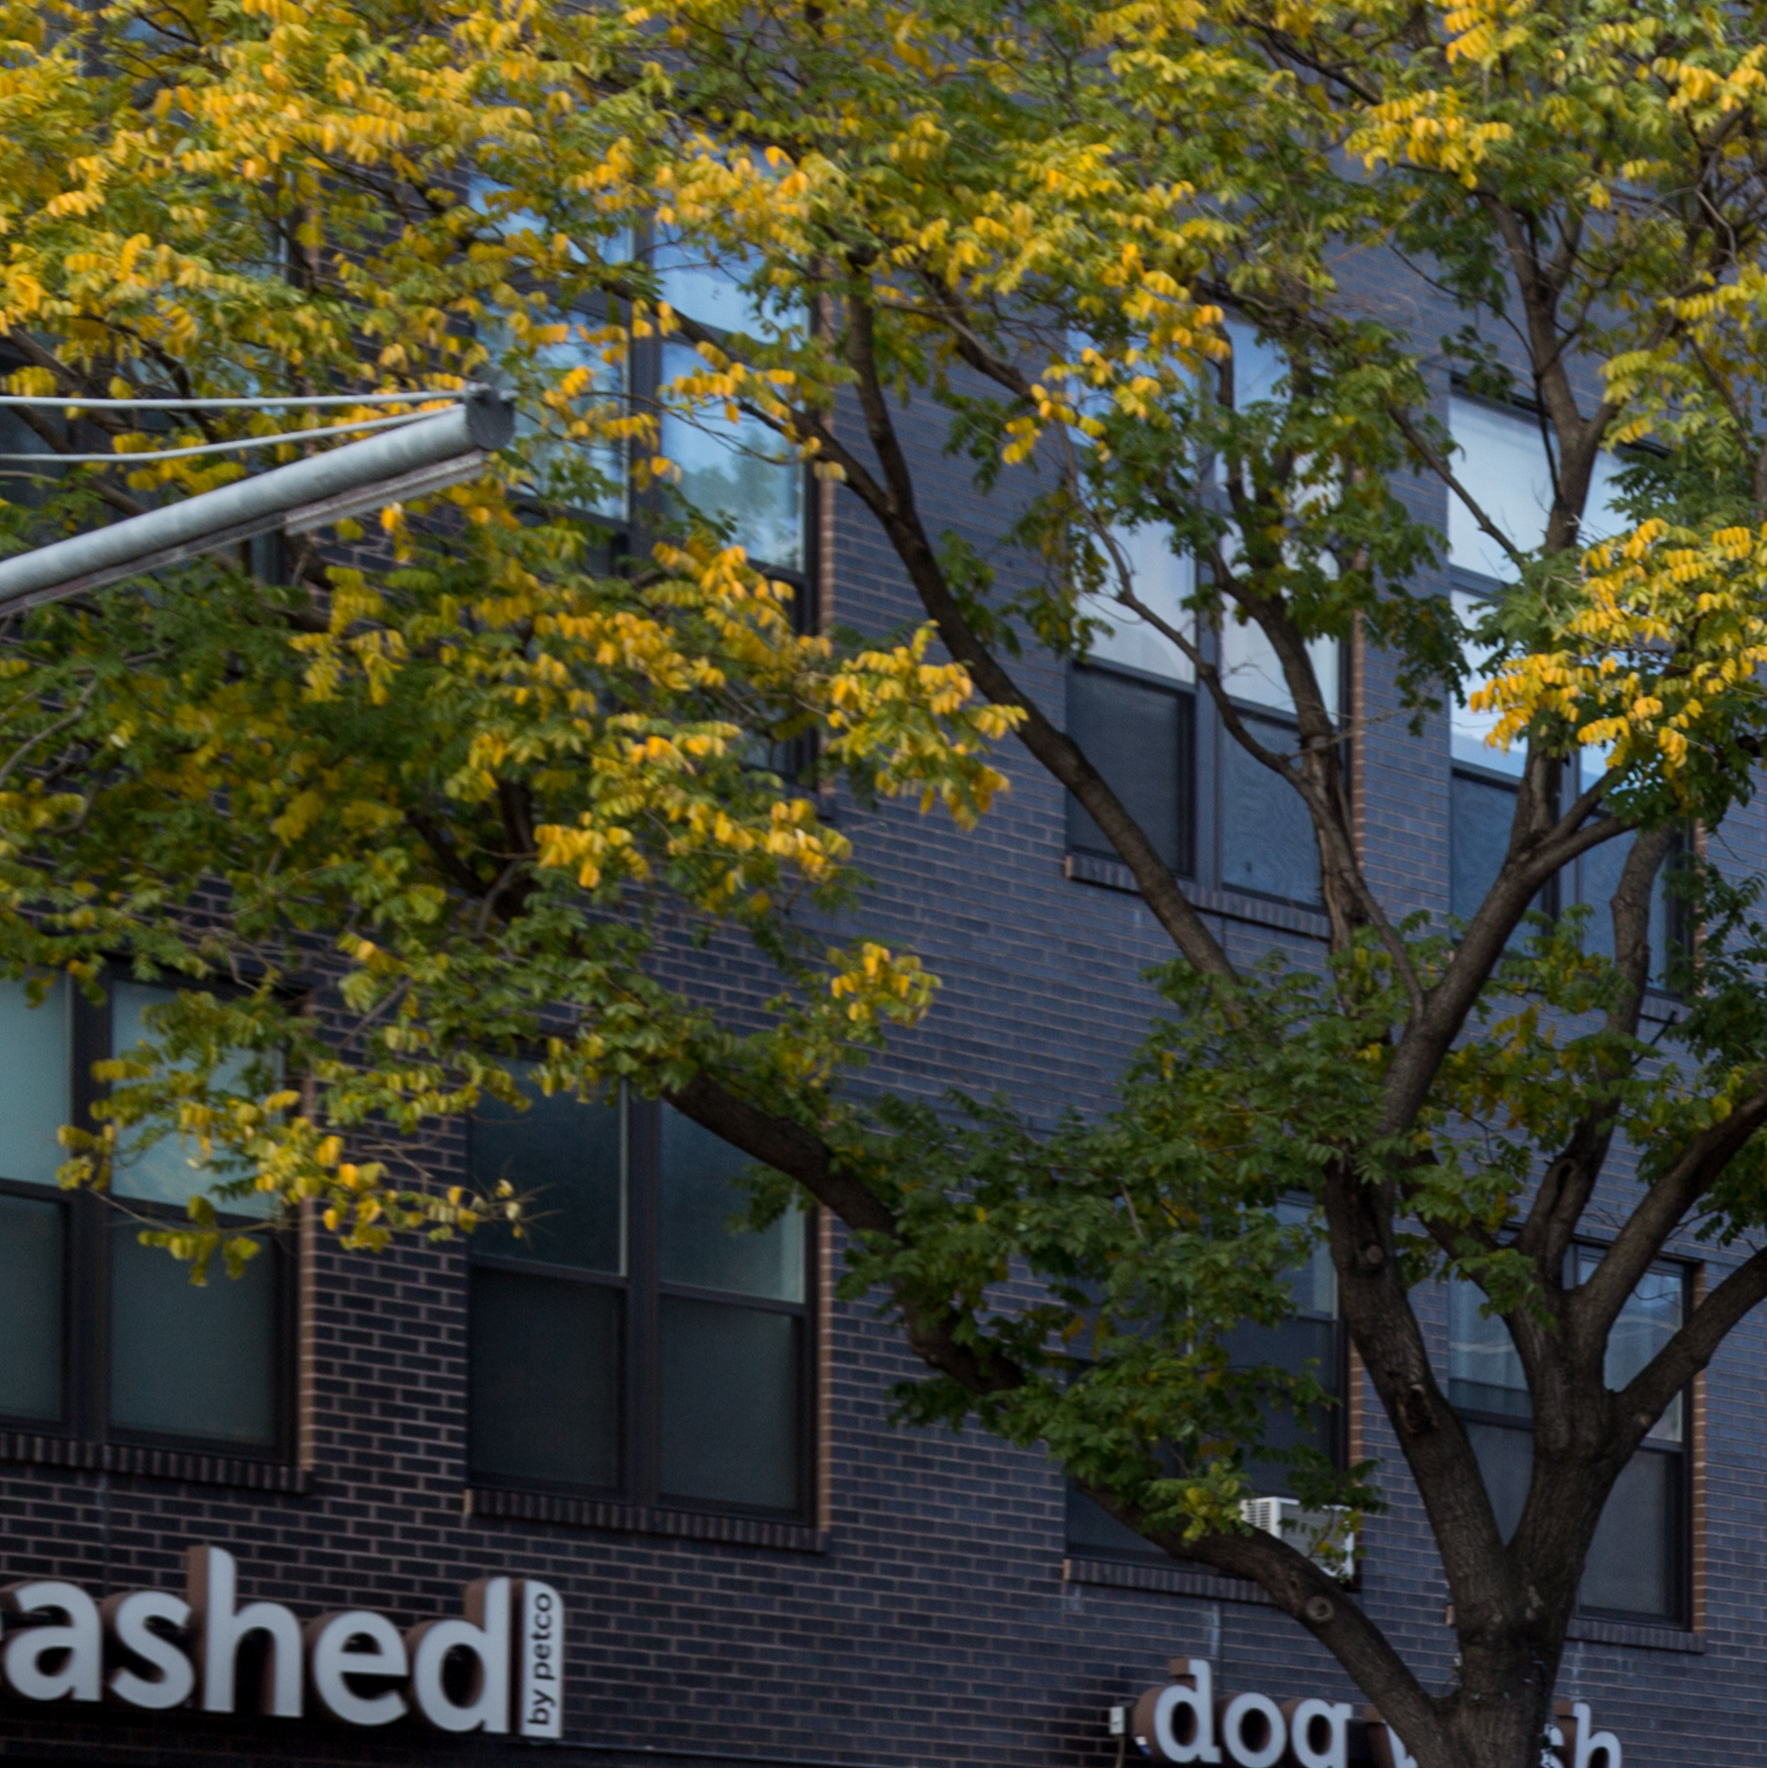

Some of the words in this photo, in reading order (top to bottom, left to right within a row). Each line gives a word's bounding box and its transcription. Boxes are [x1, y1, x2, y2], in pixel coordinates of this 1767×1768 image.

[0, 1545, 512, 1735] ashed
[527, 1591, 552, 1683] petco
[527, 1688, 551, 1728] by
